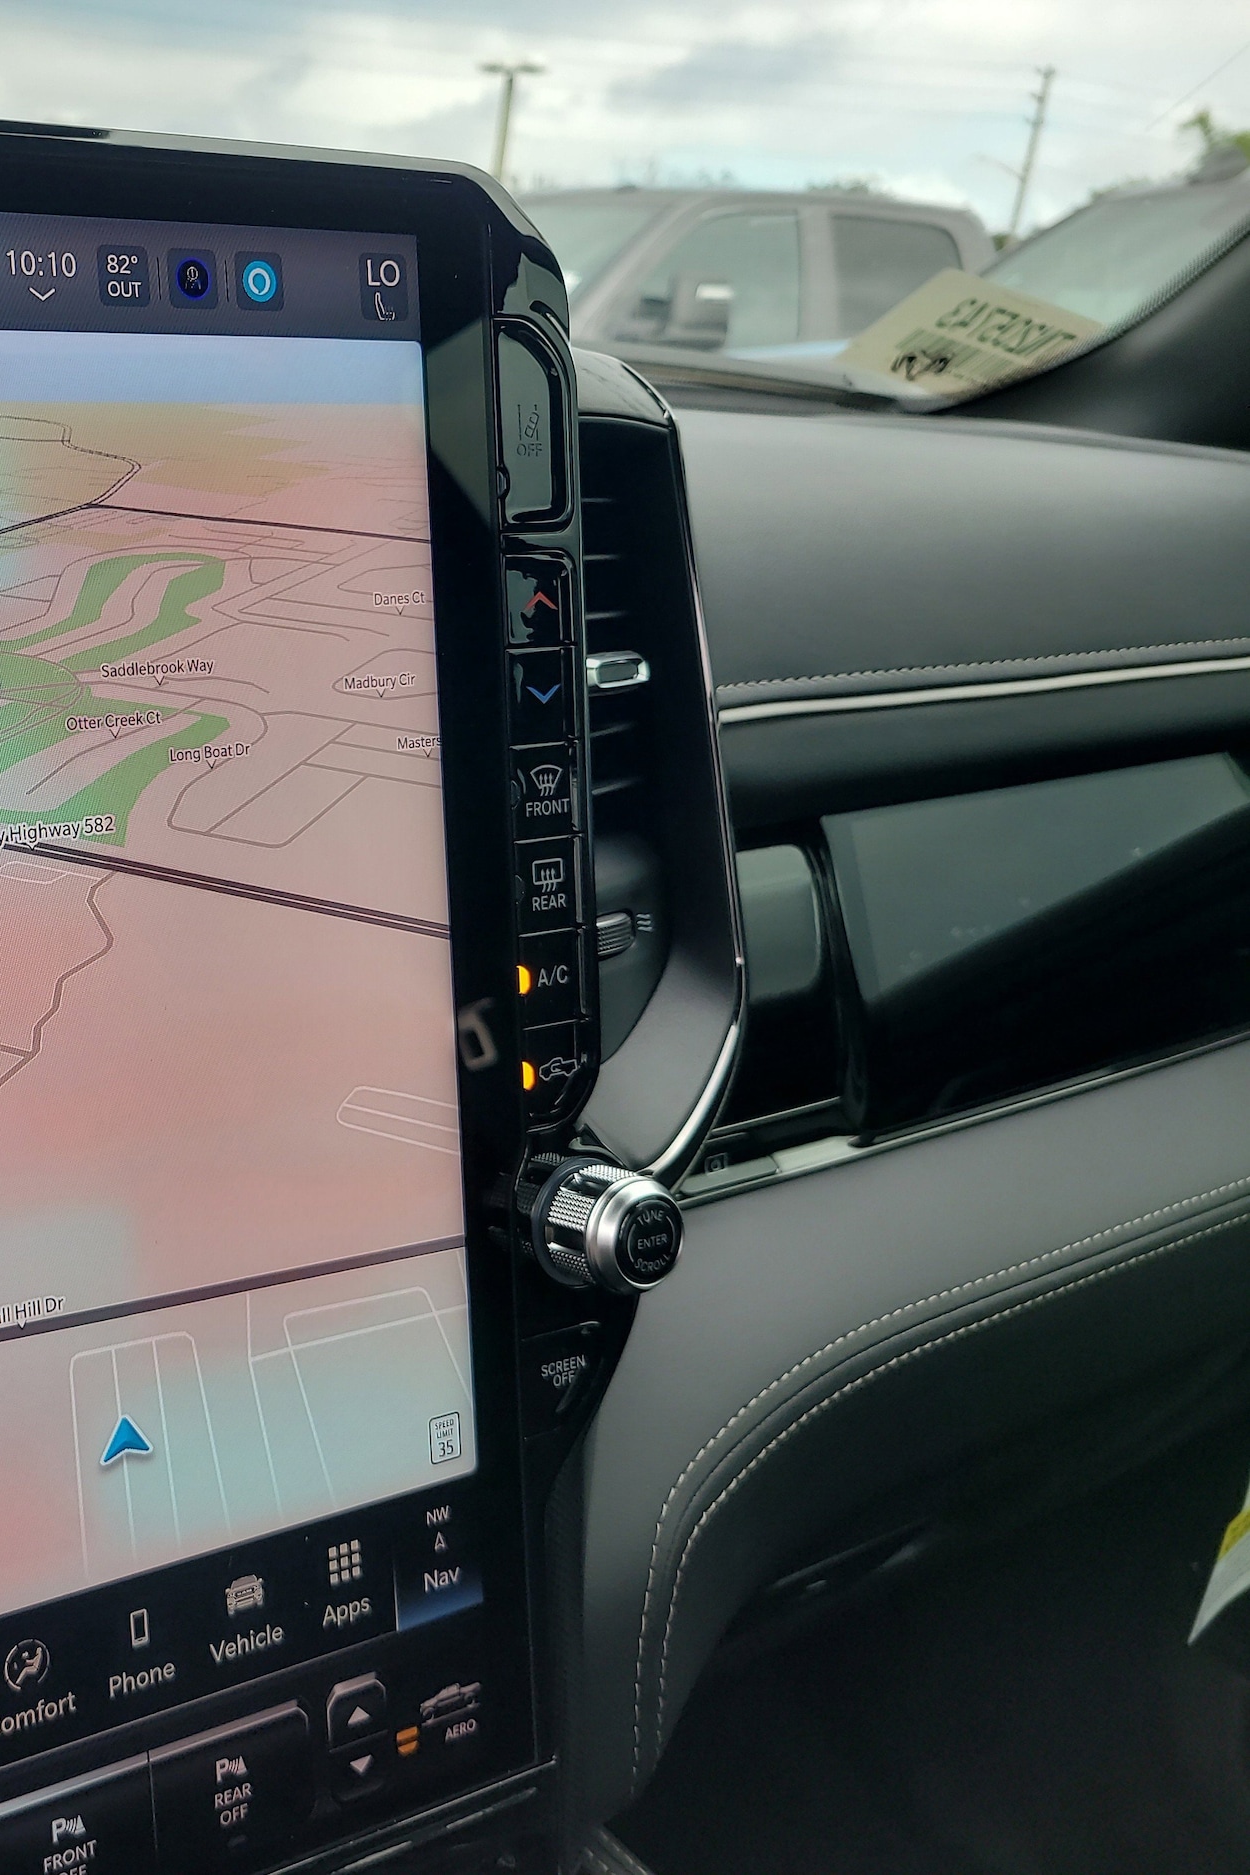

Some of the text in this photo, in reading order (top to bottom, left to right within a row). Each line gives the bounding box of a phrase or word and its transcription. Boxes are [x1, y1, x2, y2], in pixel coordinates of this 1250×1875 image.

[6, 250, 77, 278] 10:10
[107, 255, 138, 274] 82°
[367, 259, 400, 288] LO
[107, 281, 141, 299] OUT
[516, 443, 542, 457] OFF
[374, 591, 425, 606] Danes Ct
[101, 659, 214, 678] Saddlebrook Way
[344, 674, 415, 691] Madbury Cir
[66, 711, 161, 731] Otter Creek Ct
[170, 743, 251, 763] Long Boat Dr
[397, 737, 442, 750] Masters
[525, 798, 569, 818] FRONT
[10, 822, 81, 844] Highway
[85, 816, 115, 834] 582
[532, 894, 567, 912] REAR
[537, 964, 568, 989] A/C
[637, 1209, 665, 1227] TUNE
[637, 1233, 668, 1250] ENTER
[634, 1254, 671, 1273] SCROLL
[15, 1300, 41, 1320] Hill
[45, 1297, 64, 1313] Dr
[541, 1355, 586, 1380] SCREEN
[552, 1370, 576, 1388] OFF
[434, 1418, 455, 1431] SPEED
[436, 1428, 454, 1440] LIMIT
[438, 1439, 454, 1458] 35
[426, 1505, 450, 1526] NW
[424, 1566, 461, 1593] Nav
[322, 1597, 371, 1628] Apps
[209, 1624, 285, 1663] Vehicle
[109, 1661, 176, 1699] Phone
[444, 1718, 477, 1744] AERO
[214, 1783, 252, 1808] REAR
[220, 1804, 249, 1827] OFF
[43, 1840, 97, 1874] FRONT
[58, 1864, 87, 1875] FF
